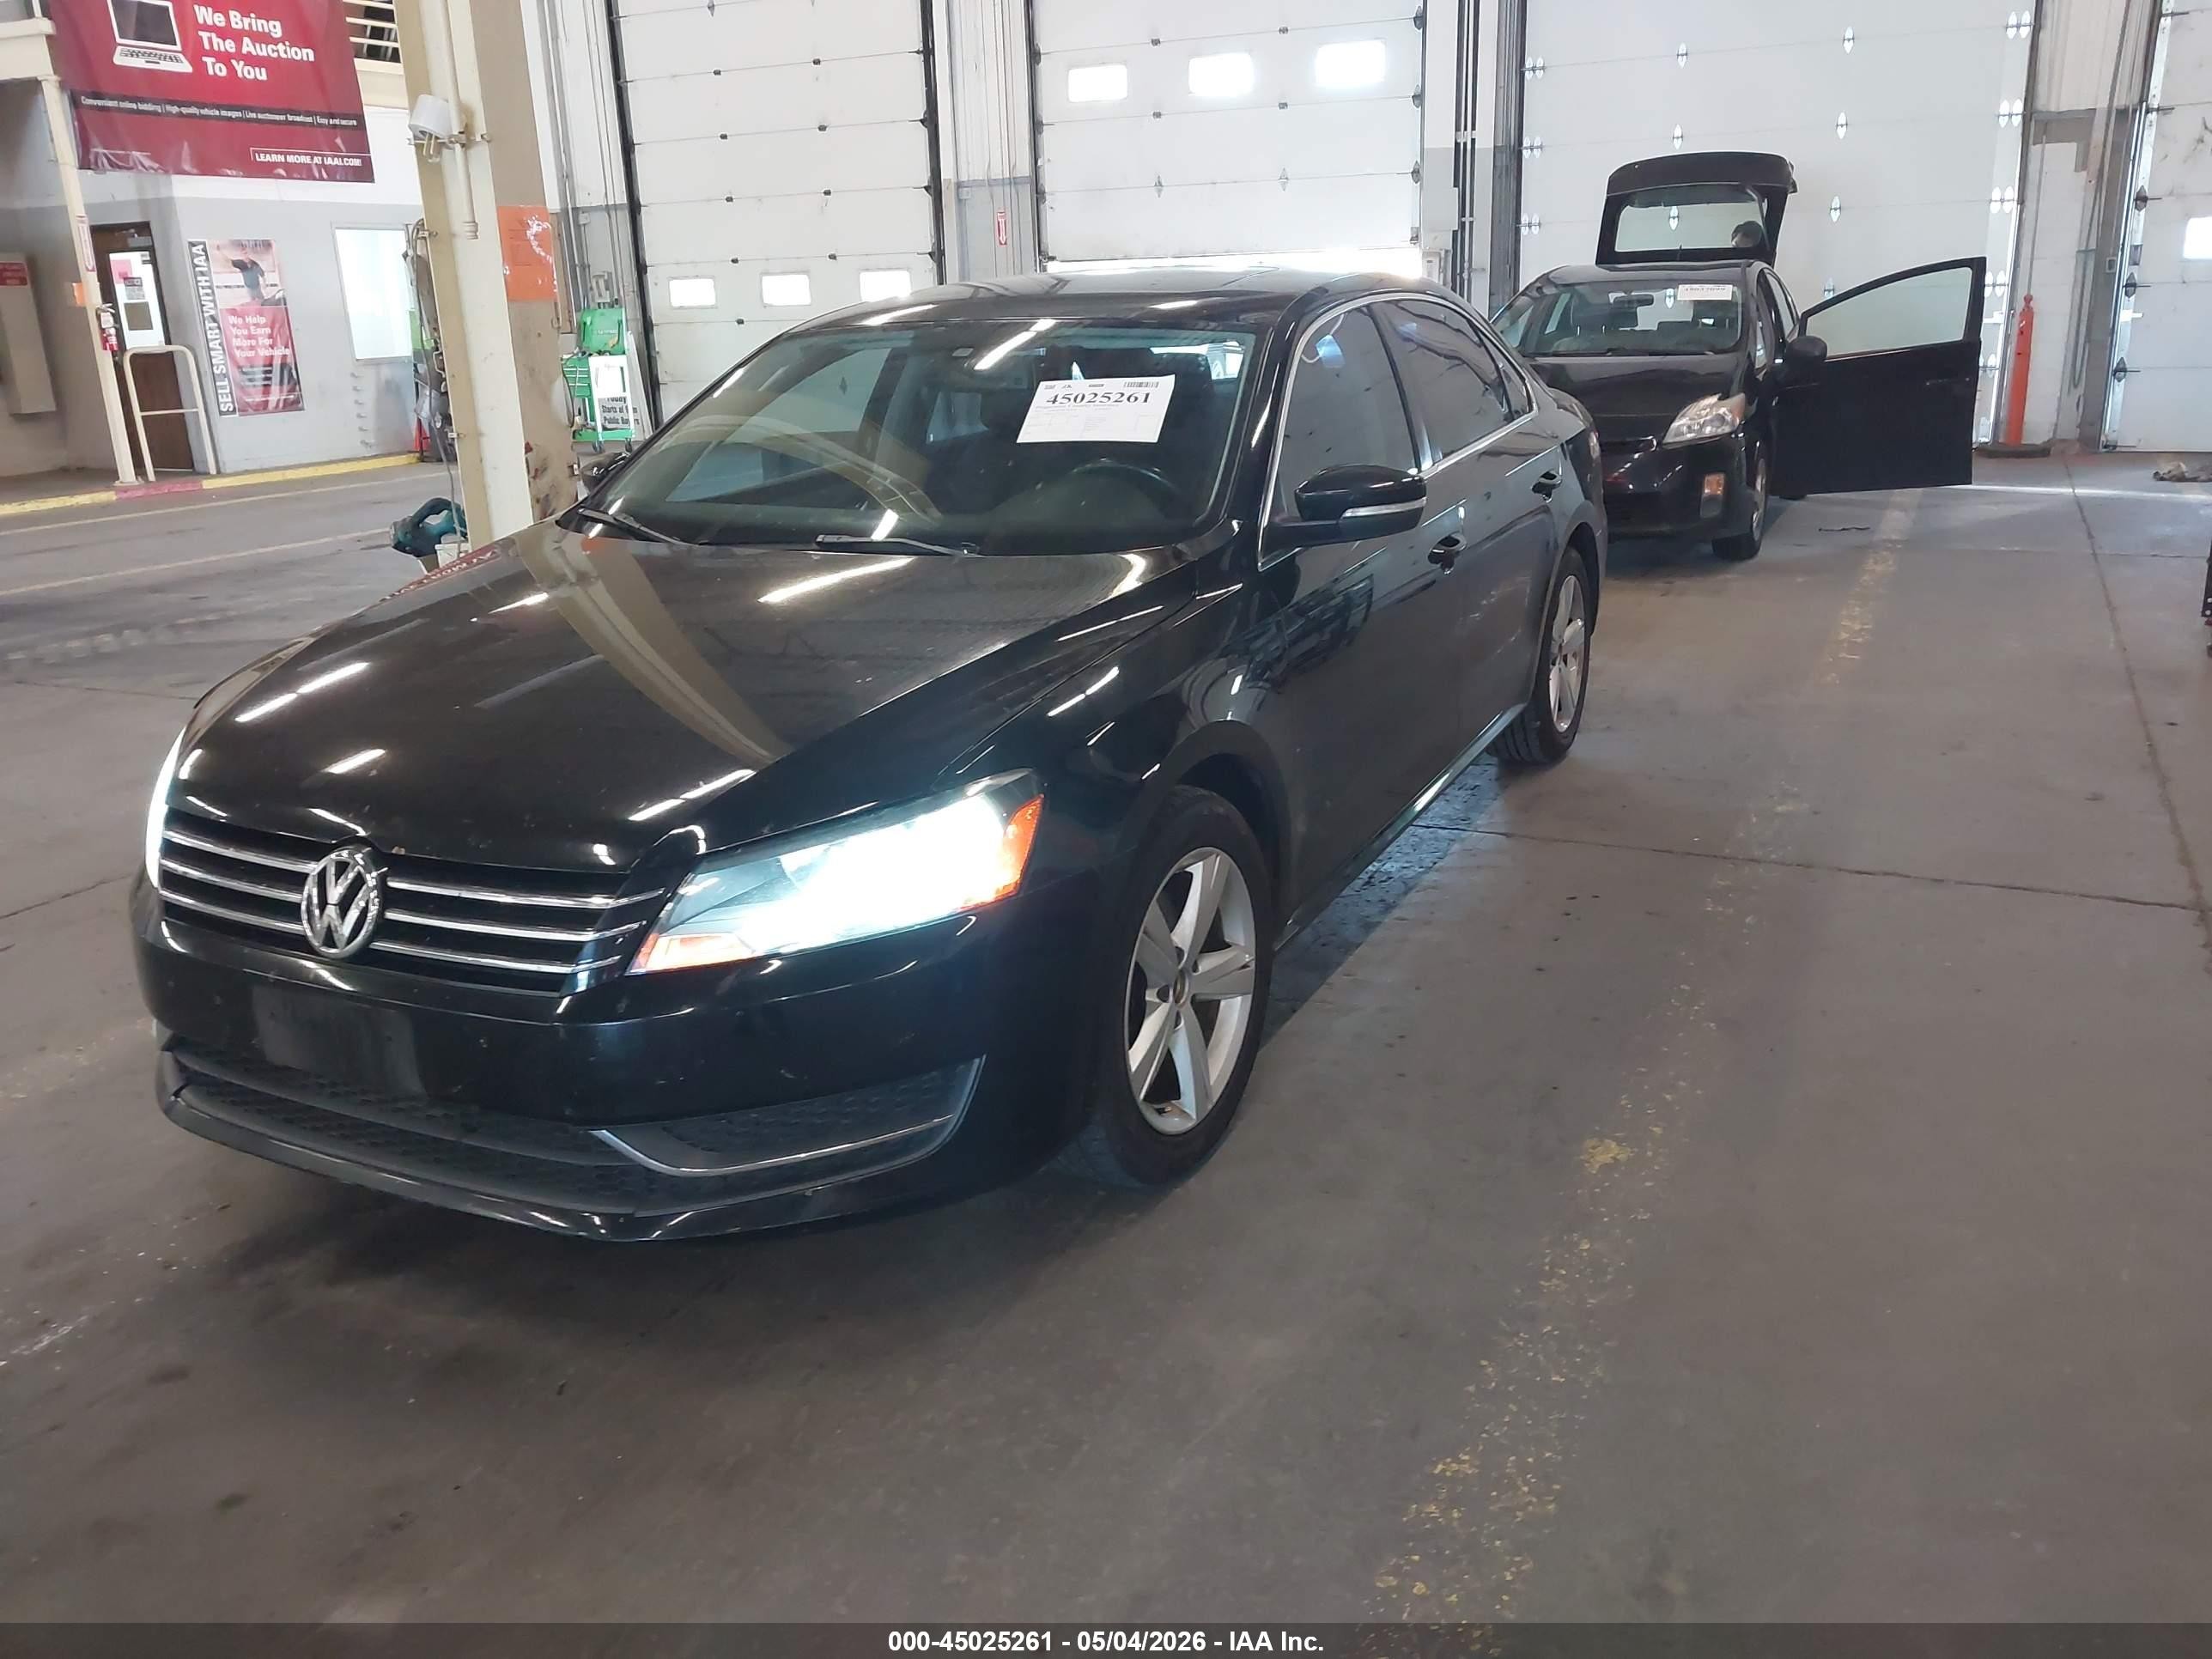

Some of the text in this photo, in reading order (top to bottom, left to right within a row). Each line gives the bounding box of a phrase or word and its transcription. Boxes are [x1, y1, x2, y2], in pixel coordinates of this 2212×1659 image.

[193, 4, 283, 38] We Bring
[198, 30, 315, 62] The Auction
[202, 56, 268, 81] To You
[246, 109, 257, 118] Live
[255, 152, 285, 164] LEARN
[286, 155, 312, 165] MORE
[313, 155, 323, 165] AT
[228, 314, 266, 325] We Help
[191, 243, 234, 413] SELL SMART WITH IAA
[231, 325, 271, 335] You Earn
[233, 337, 273, 346] More For
[234, 346, 290, 358] Your Vehicle
[1046, 392, 1152, 404] 45025261
[603, 416, 620, 425] Public
